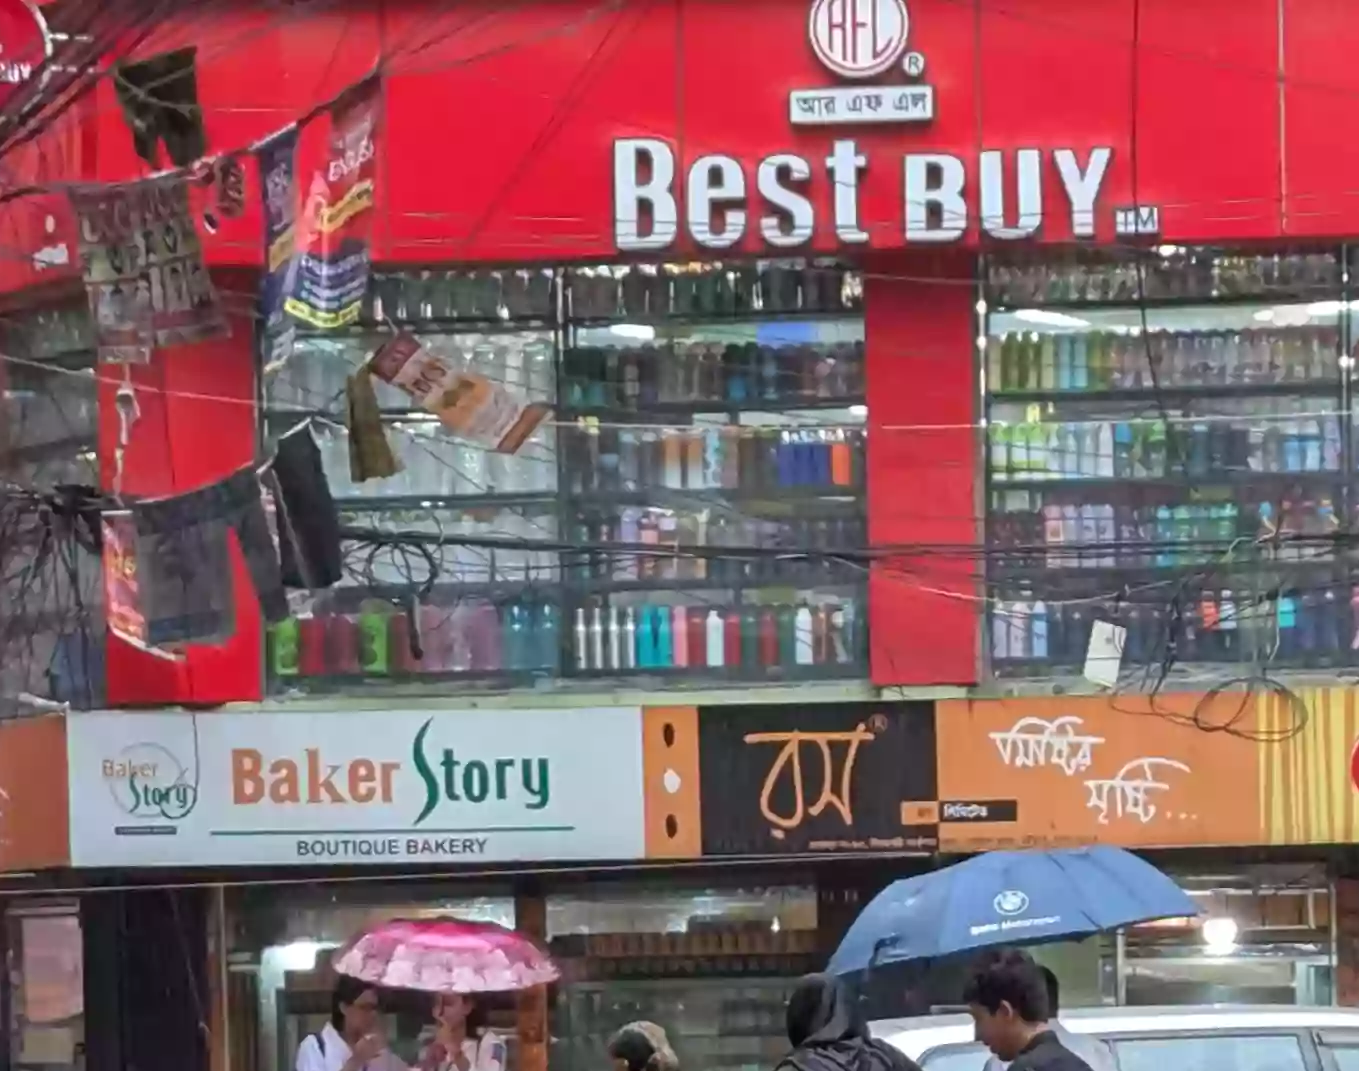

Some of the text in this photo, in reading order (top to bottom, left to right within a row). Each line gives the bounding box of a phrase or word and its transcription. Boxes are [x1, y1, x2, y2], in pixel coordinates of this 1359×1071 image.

[796, 92, 927, 116] আর এফ এল
[613, 137, 870, 252] Best
[904, 146, 1113, 244] BUY
[102, 757, 159, 777] Baker
[230, 716, 551, 827] Baker Story
[295, 837, 488, 857] BOUTIQUE BAKERY
